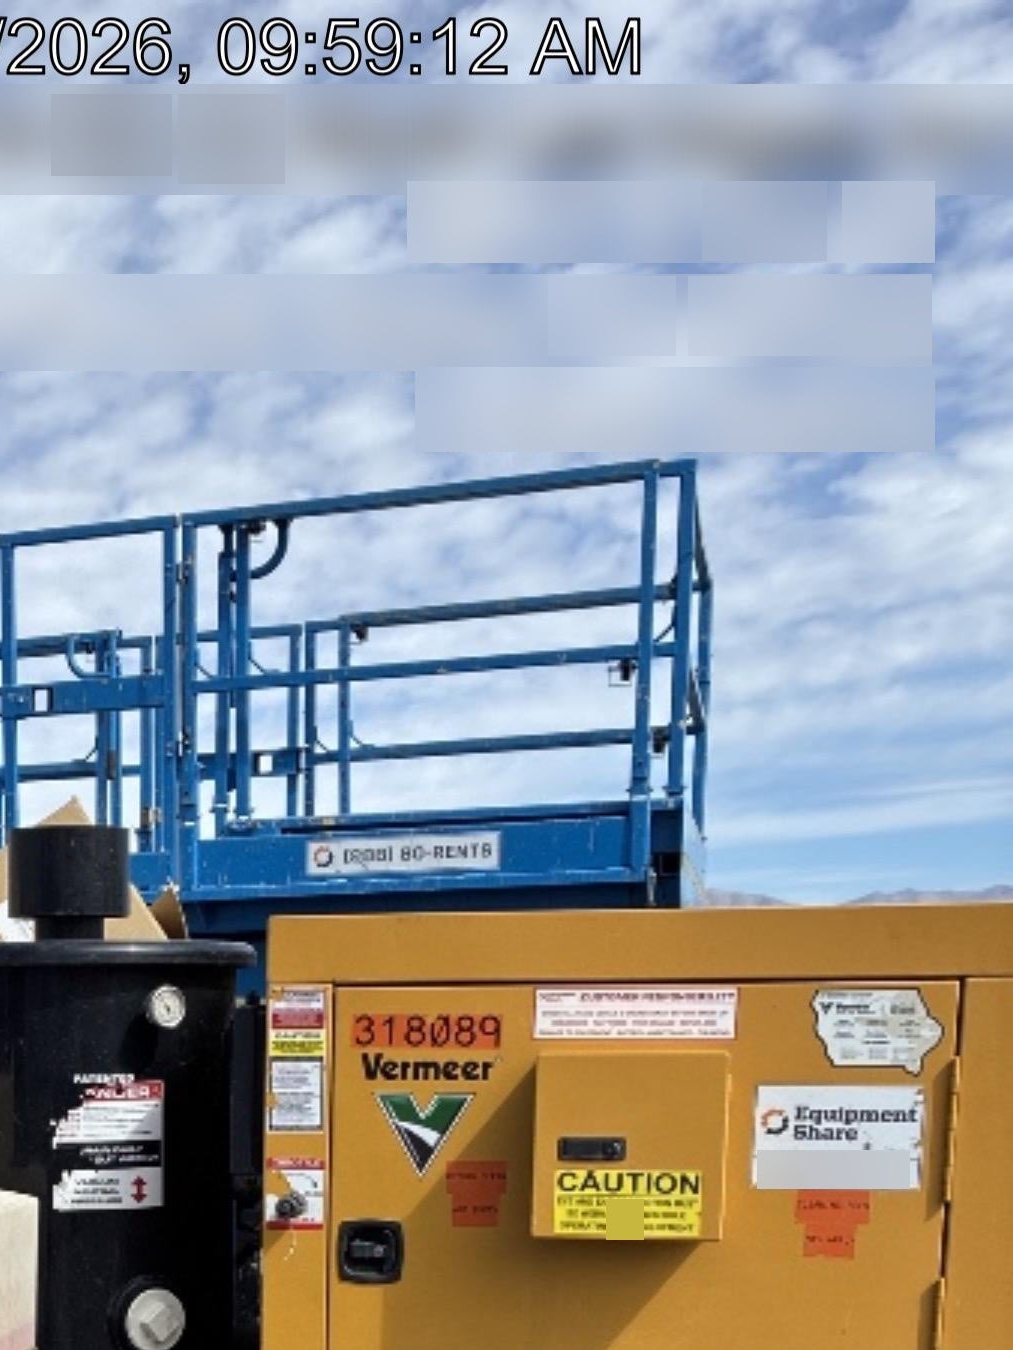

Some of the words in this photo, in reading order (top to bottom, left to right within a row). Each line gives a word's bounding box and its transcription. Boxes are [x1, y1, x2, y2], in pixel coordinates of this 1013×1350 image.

[354, 1014, 502, 1048] 318089
[361, 1052, 494, 1081] Vermeer
[793, 1105, 919, 1126] Equipment
[793, 1124, 859, 1142] Share
[557, 1171, 700, 1195] CAUTION
